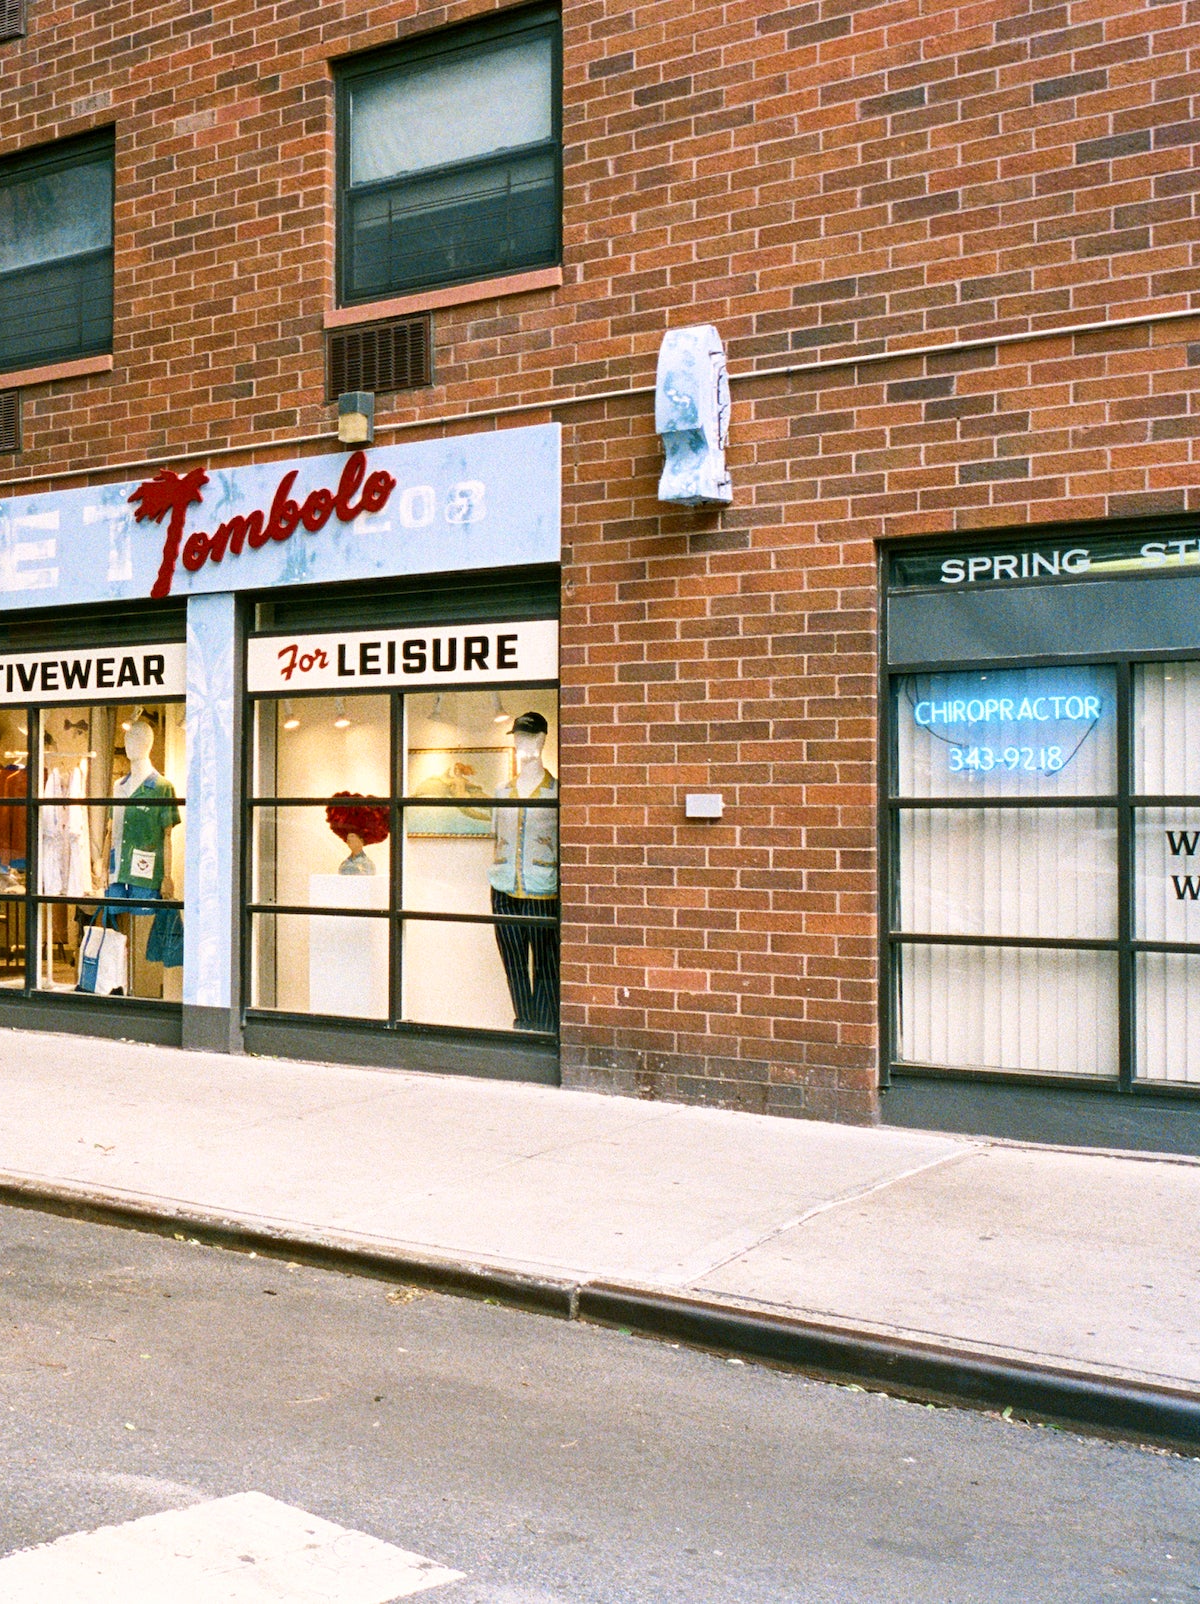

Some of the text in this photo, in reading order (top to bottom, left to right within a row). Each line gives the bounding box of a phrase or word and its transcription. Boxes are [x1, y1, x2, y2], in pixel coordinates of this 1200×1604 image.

[128, 450, 396, 599] Tombolo
[940, 538, 1200, 584] SPRING ST
[277, 633, 519, 681] For LEISURE
[915, 696, 1101, 725] CHIROPRACTOR
[949, 746, 1064, 772] 343-9218
